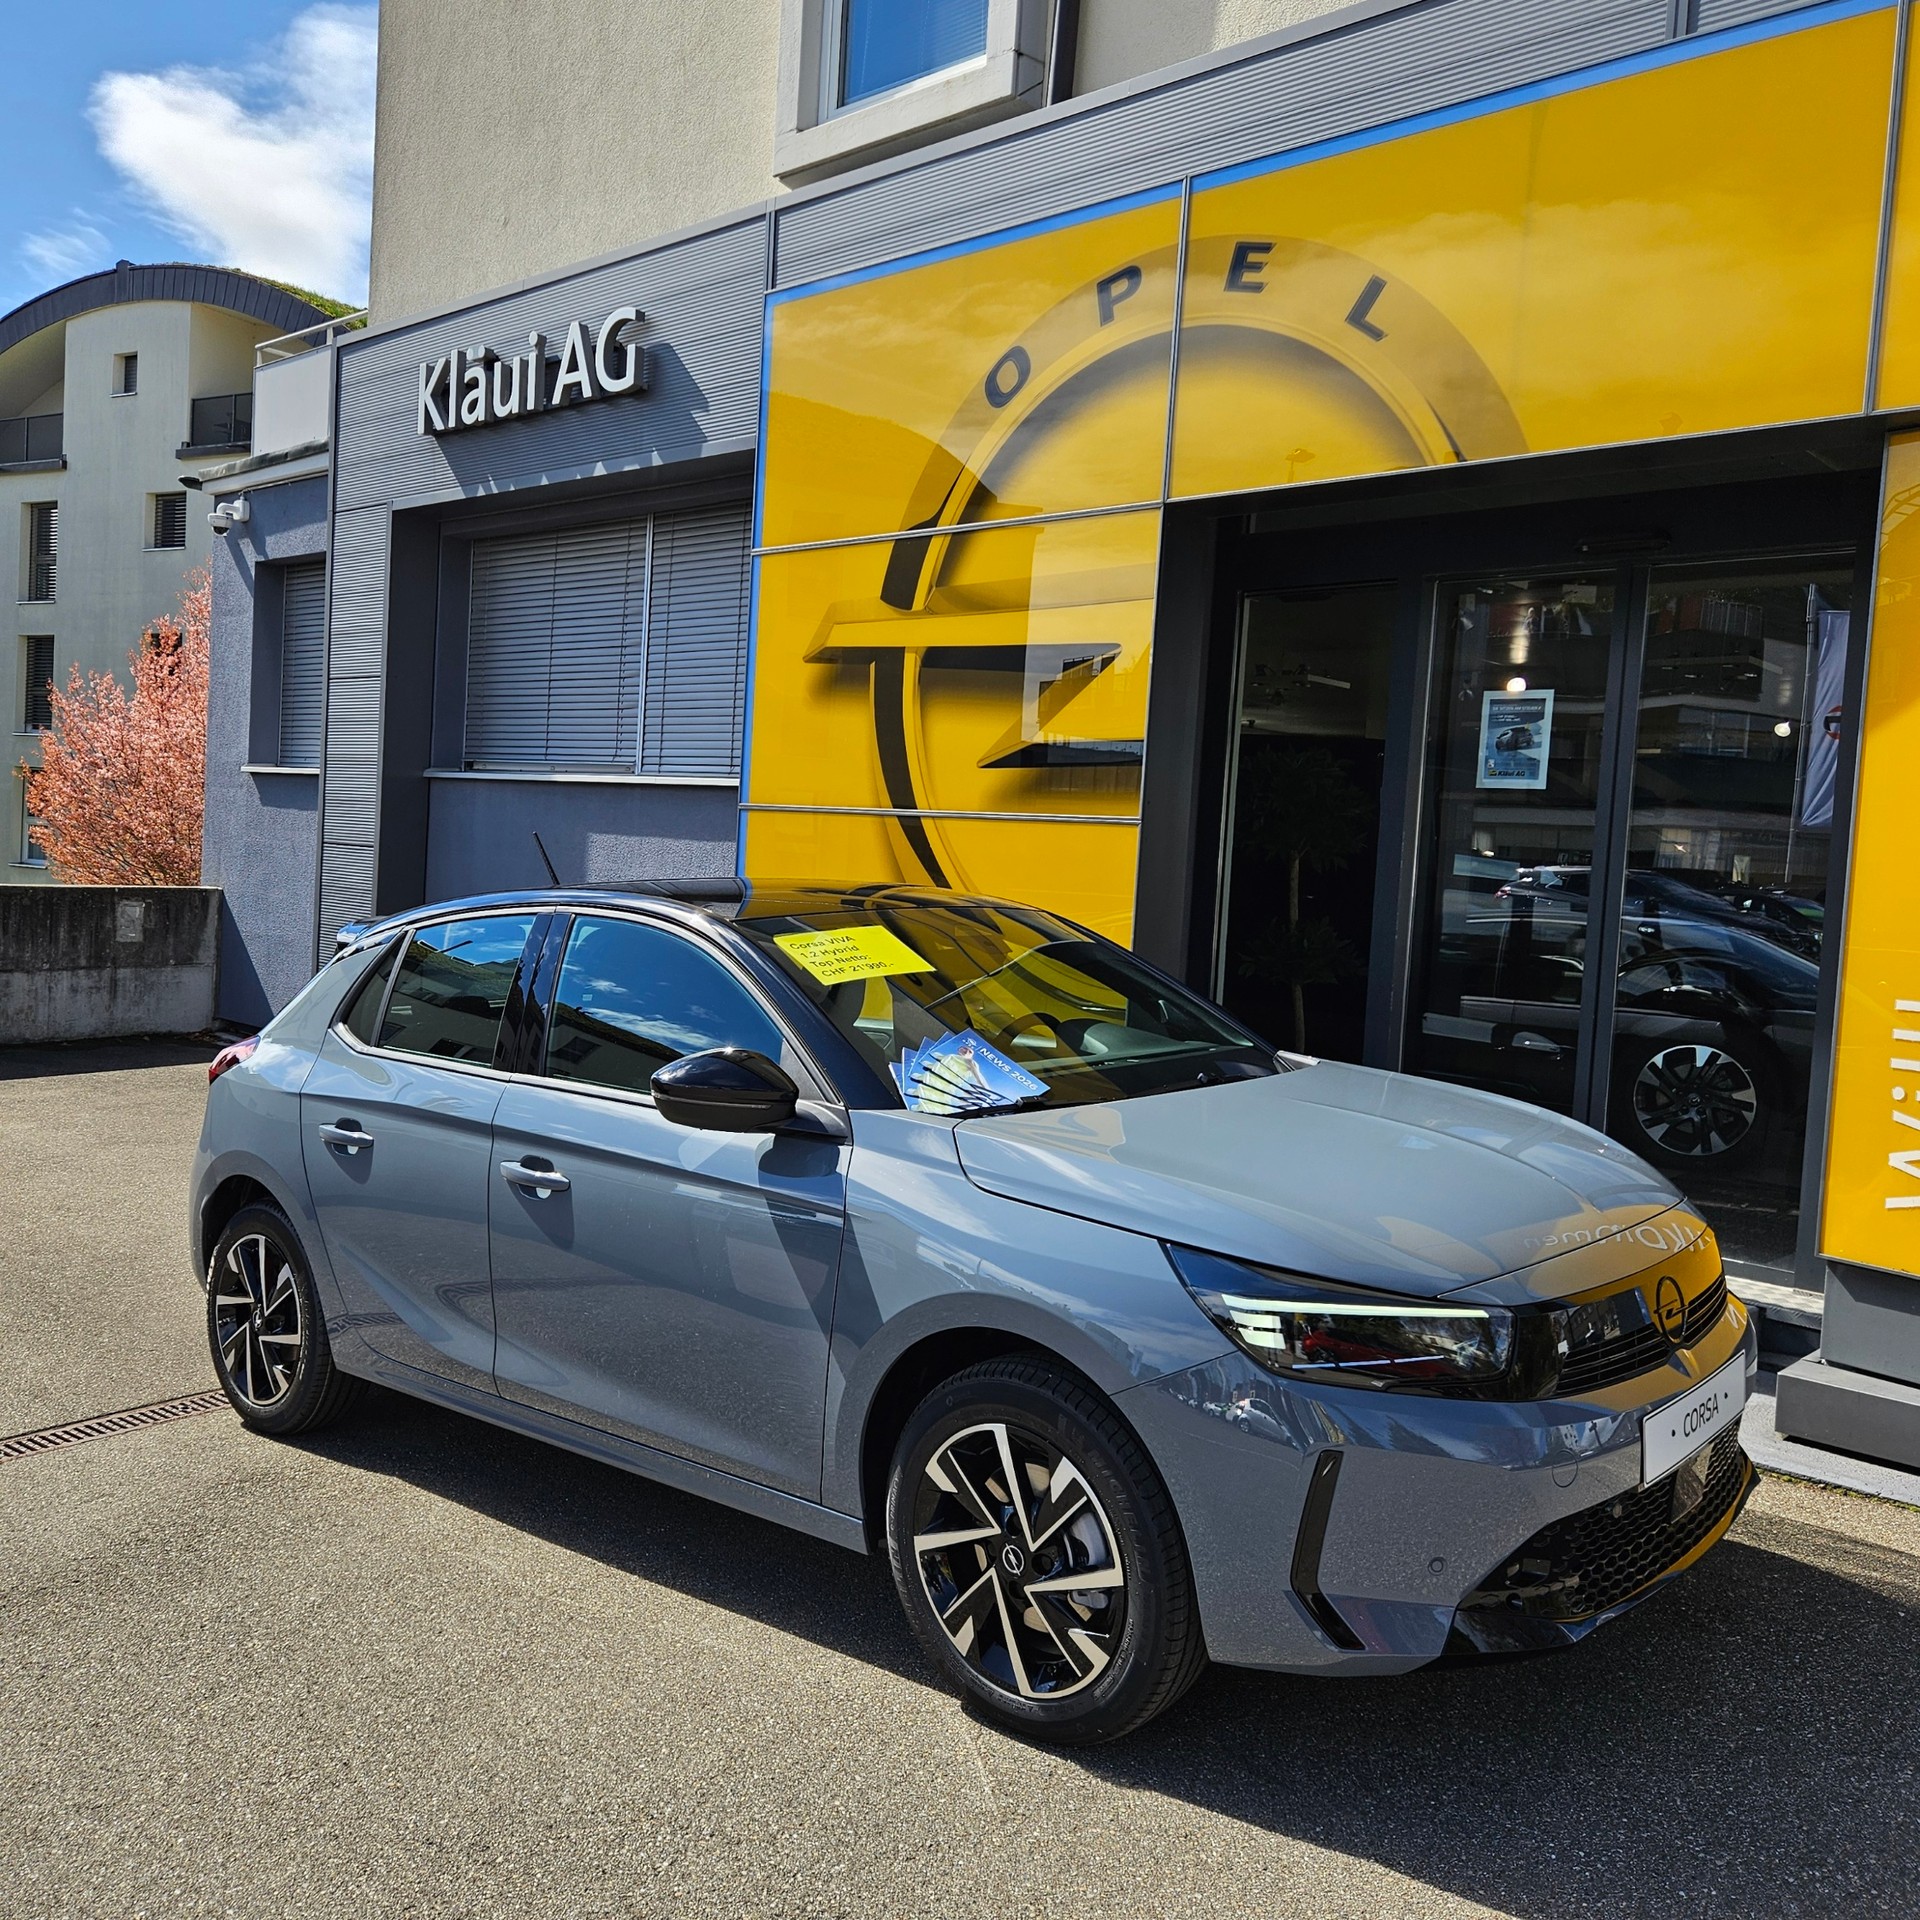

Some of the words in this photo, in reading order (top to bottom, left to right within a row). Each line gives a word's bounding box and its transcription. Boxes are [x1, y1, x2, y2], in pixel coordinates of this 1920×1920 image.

[984, 241, 1389, 409] OPEL
[417, 330, 547, 435] Kläui
[552, 306, 647, 405] AG
[789, 940, 825, 950] Corsa
[826, 935, 855, 946] VIVA
[800, 952, 820, 960] 1.2
[821, 944, 860, 956] Hybrid
[809, 959, 834, 969] Top
[836, 954, 871, 964] Netto:
[821, 967, 846, 977] CHF
[980, 1047, 1011, 1073] NEWS
[1011, 1070, 1038, 1091] 2026
[1683, 1393, 1719, 1438] CORSA
